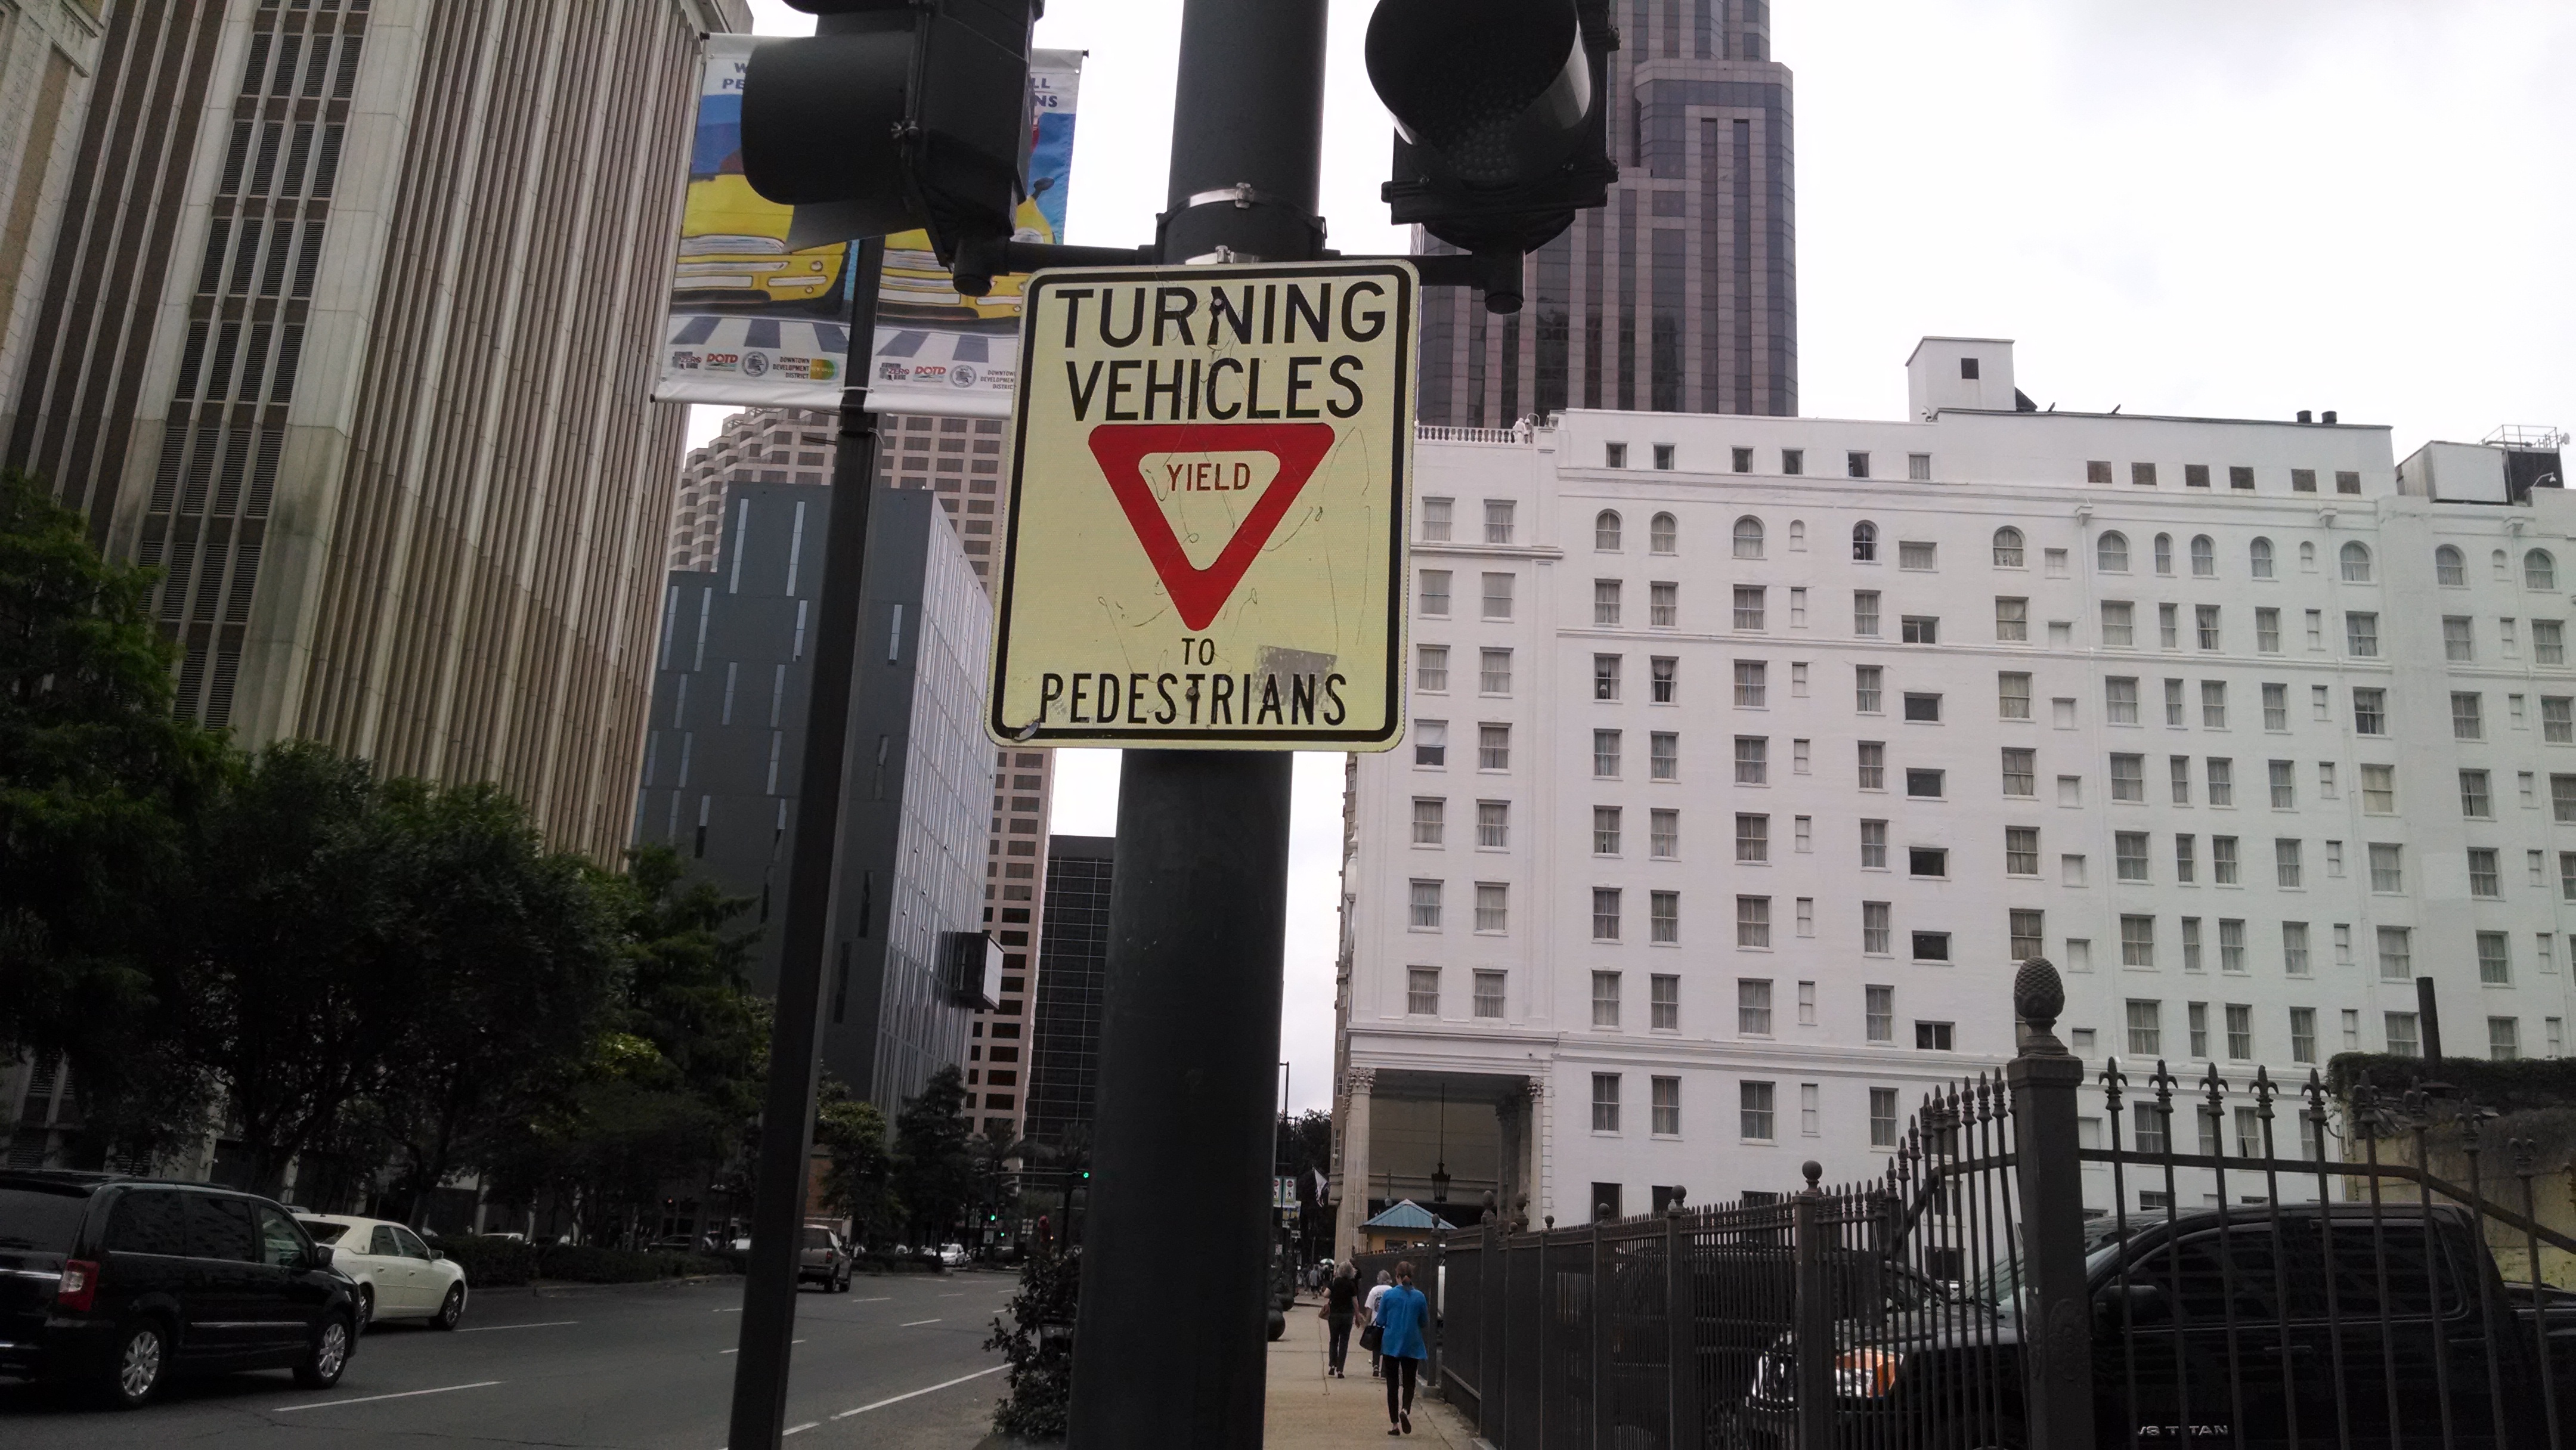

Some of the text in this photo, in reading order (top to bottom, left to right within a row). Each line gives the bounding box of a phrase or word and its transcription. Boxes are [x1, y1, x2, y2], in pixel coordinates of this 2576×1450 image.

[1055, 281, 1386, 349] TURNING
[707, 353, 738, 363] DOTD
[915, 366, 946, 374] DOTD
[1066, 355, 1364, 422] VEHICLES
[1166, 463, 1250, 492] YIELD
[1181, 638, 1215, 666] TO
[1039, 673, 1346, 726] PEDESTRIANS
[2165, 1425, 2228, 1436] TTAN
